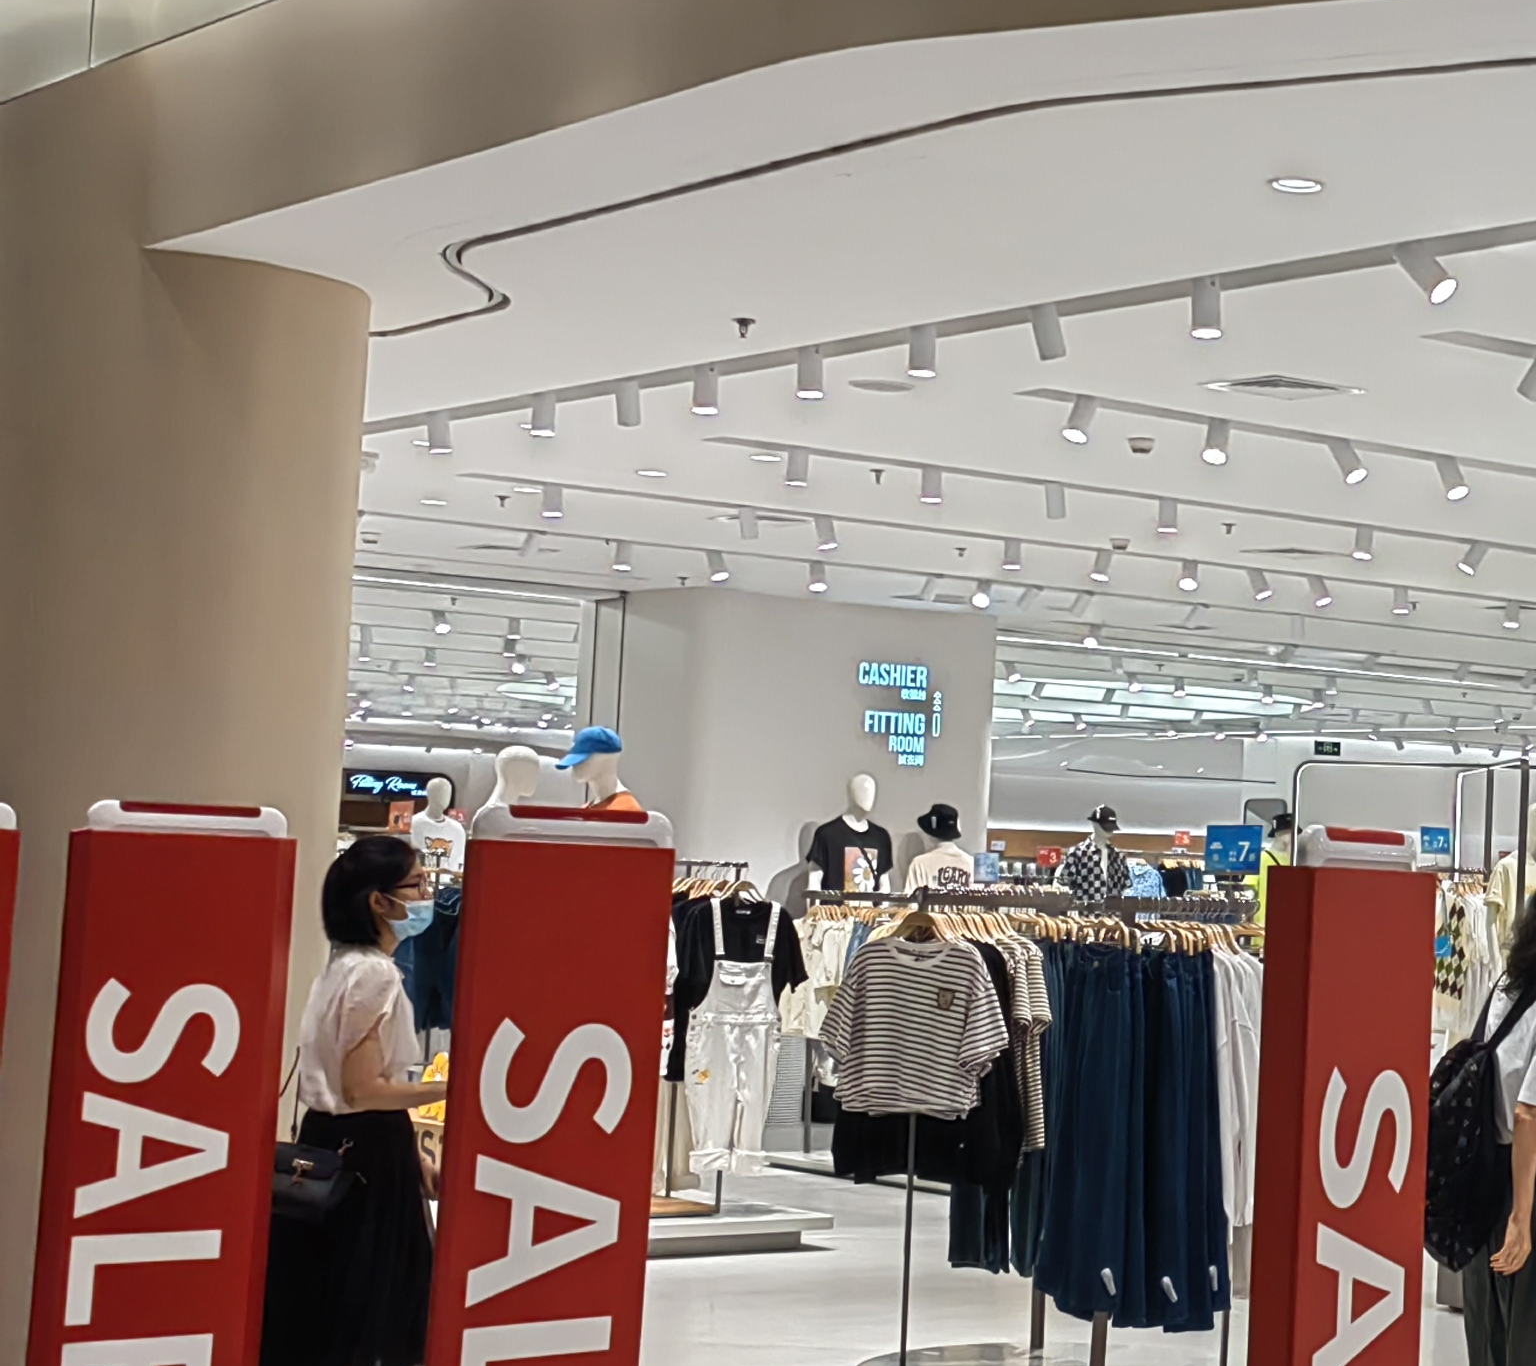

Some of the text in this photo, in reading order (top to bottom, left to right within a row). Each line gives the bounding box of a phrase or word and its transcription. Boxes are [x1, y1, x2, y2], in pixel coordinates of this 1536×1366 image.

[858, 661, 928, 688] CASHIER
[864, 710, 926, 735] FITTING
[888, 735, 925, 753] ROOM
